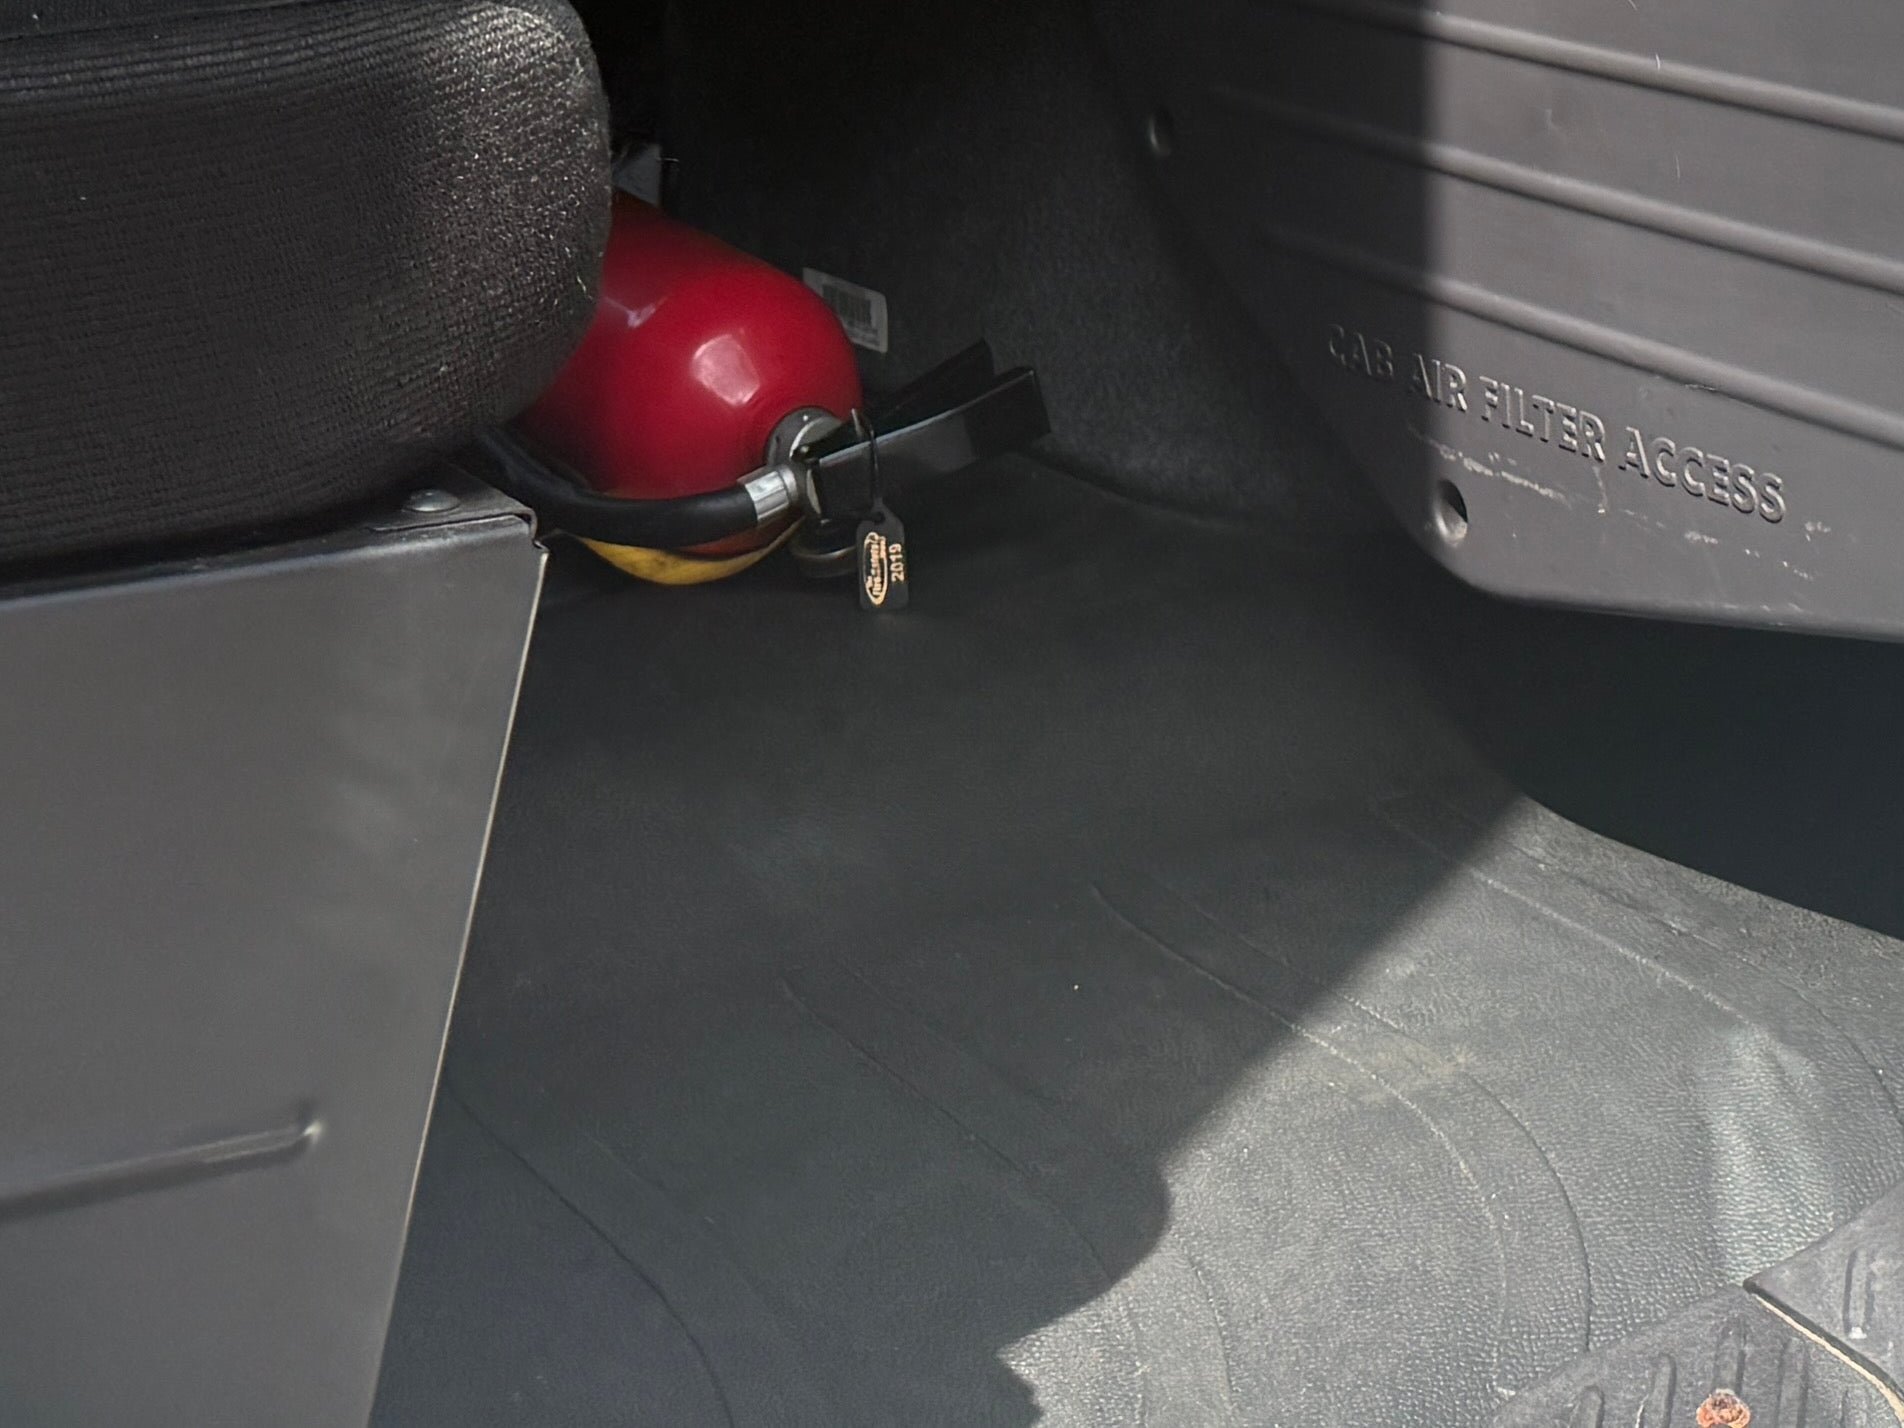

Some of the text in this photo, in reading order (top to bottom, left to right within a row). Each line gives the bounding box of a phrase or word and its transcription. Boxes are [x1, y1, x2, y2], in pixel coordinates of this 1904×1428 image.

[1327, 323, 1787, 523] CAB AIR FILTER ACCESS
[888, 543, 905, 582] 2019
